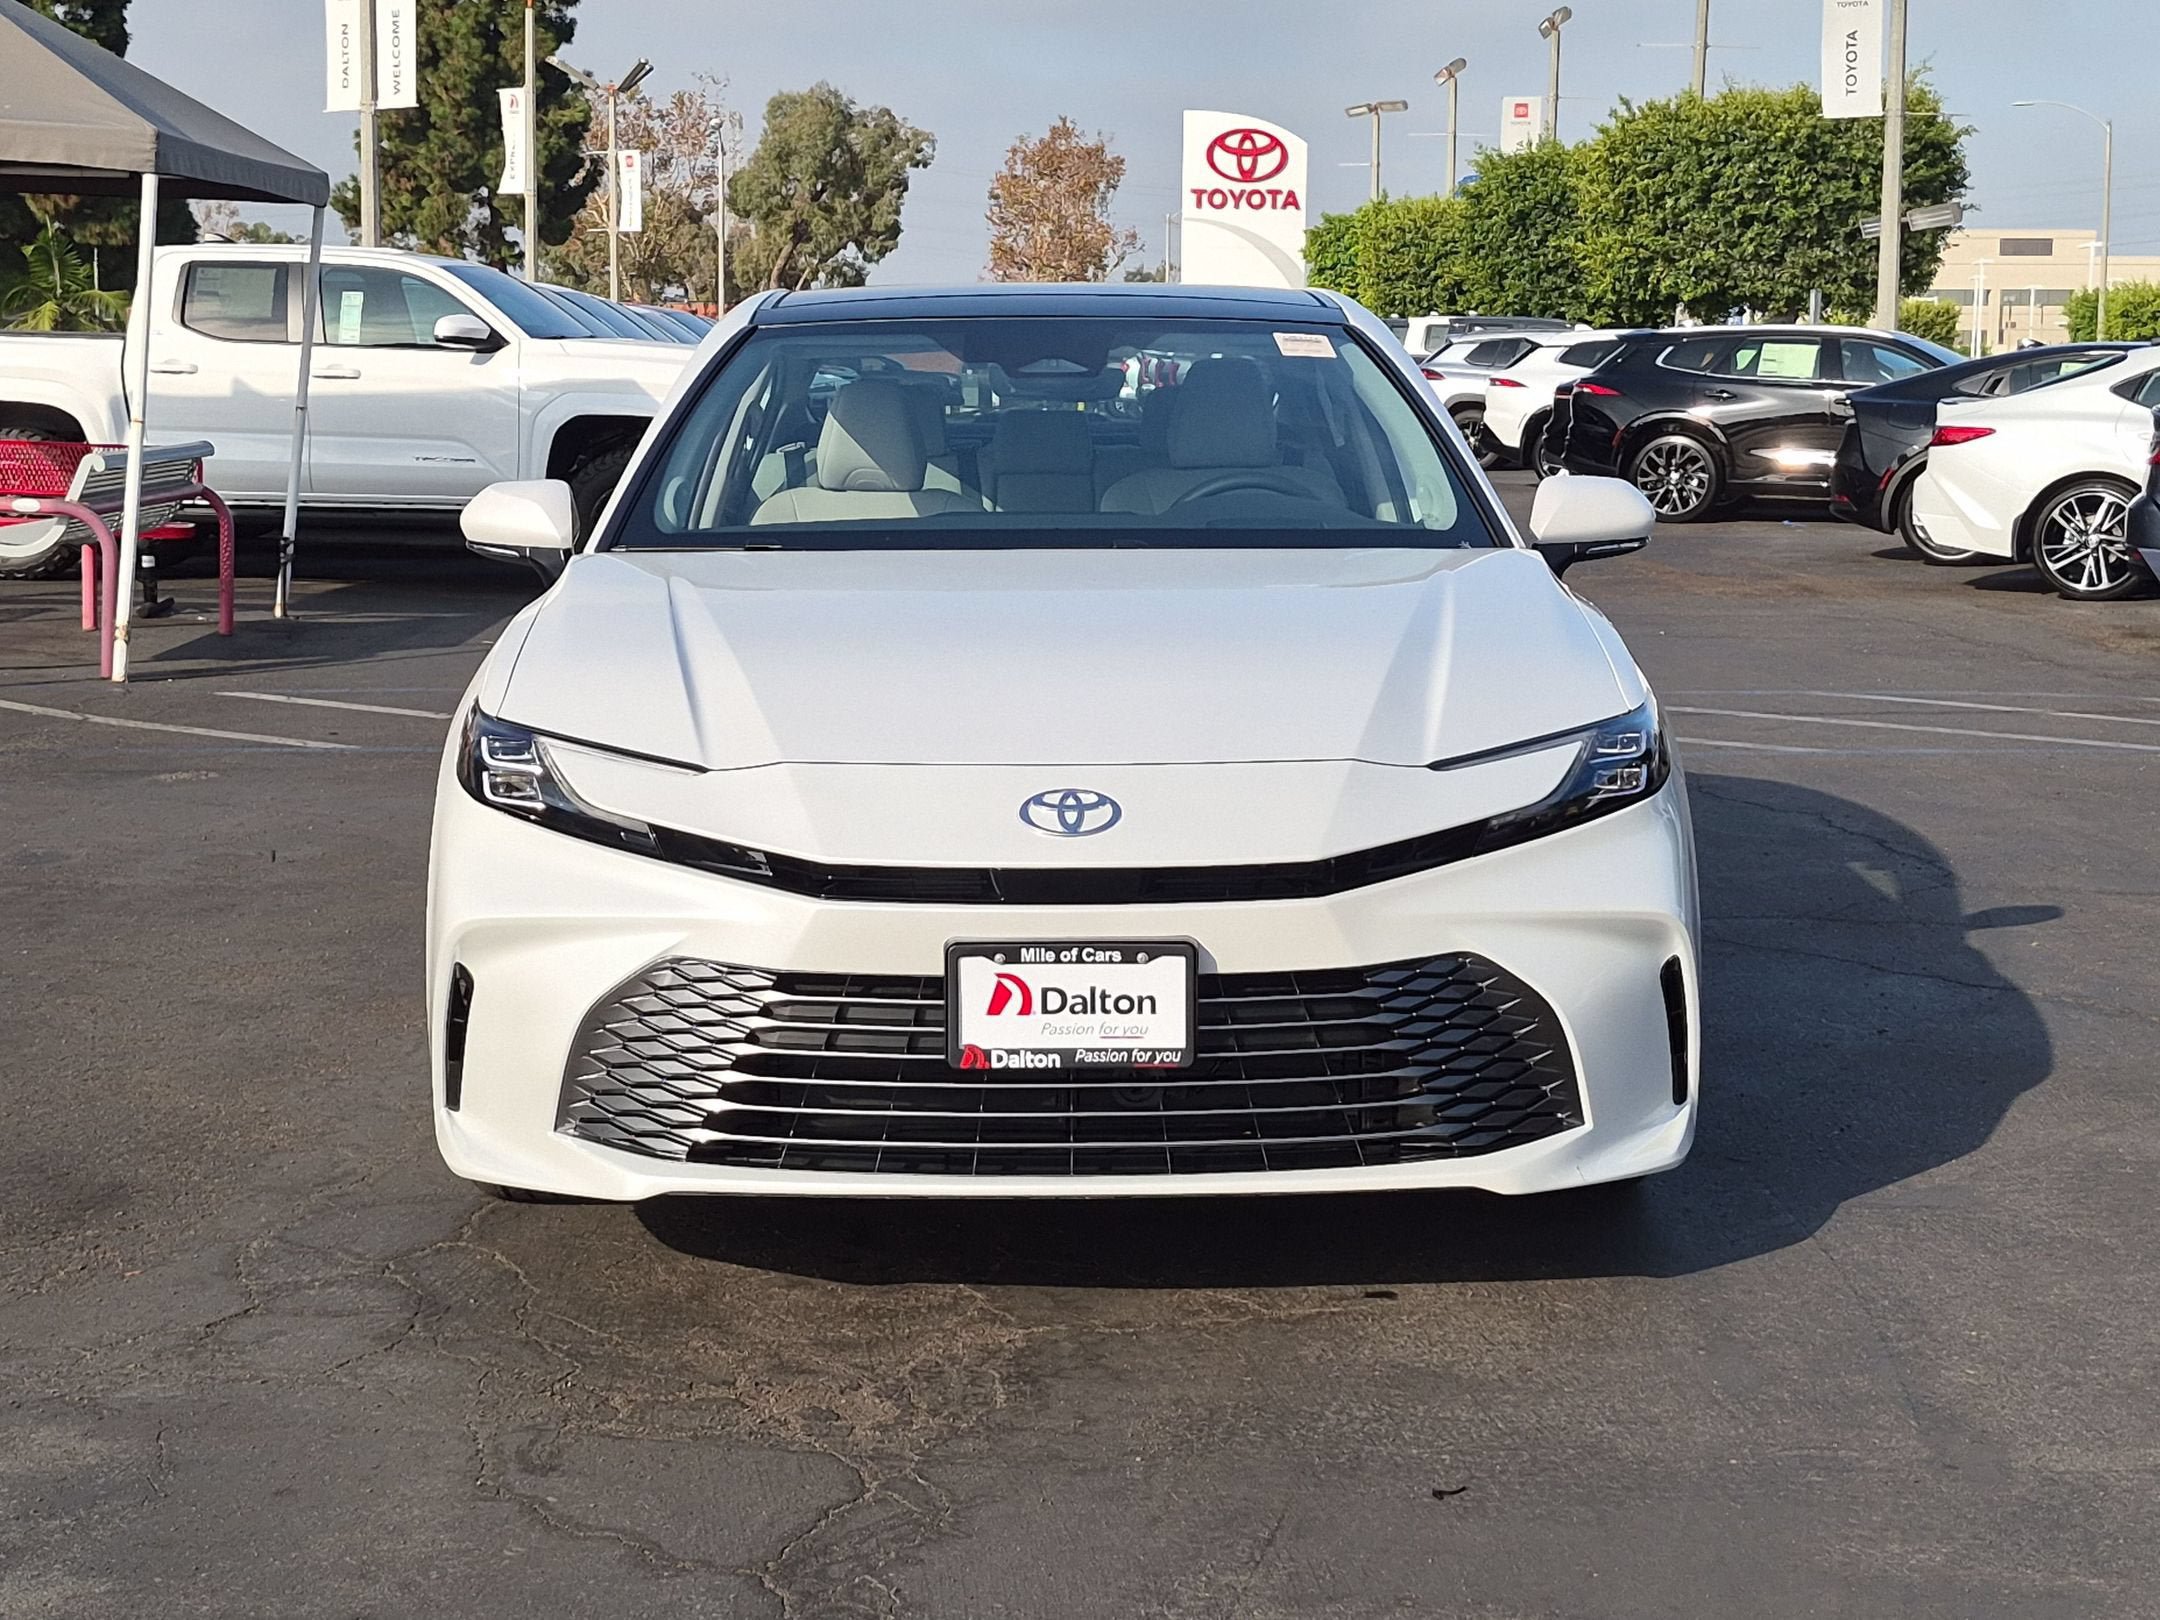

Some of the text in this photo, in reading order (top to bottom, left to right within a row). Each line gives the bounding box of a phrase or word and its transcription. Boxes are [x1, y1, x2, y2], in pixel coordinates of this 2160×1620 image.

[341, 24, 349, 88] DALTON
[392, 9, 400, 95] WELCOME
[1846, 30, 1858, 96] TOYOTA
[1190, 188, 1301, 210] TOYOTA
[1020, 947, 1122, 962] Mile of Cars
[1041, 986, 1157, 1015] Dalton
[1041, 1021, 1149, 1036] Passion for you
[990, 1048, 1181, 1069] Dalton Passion for you
